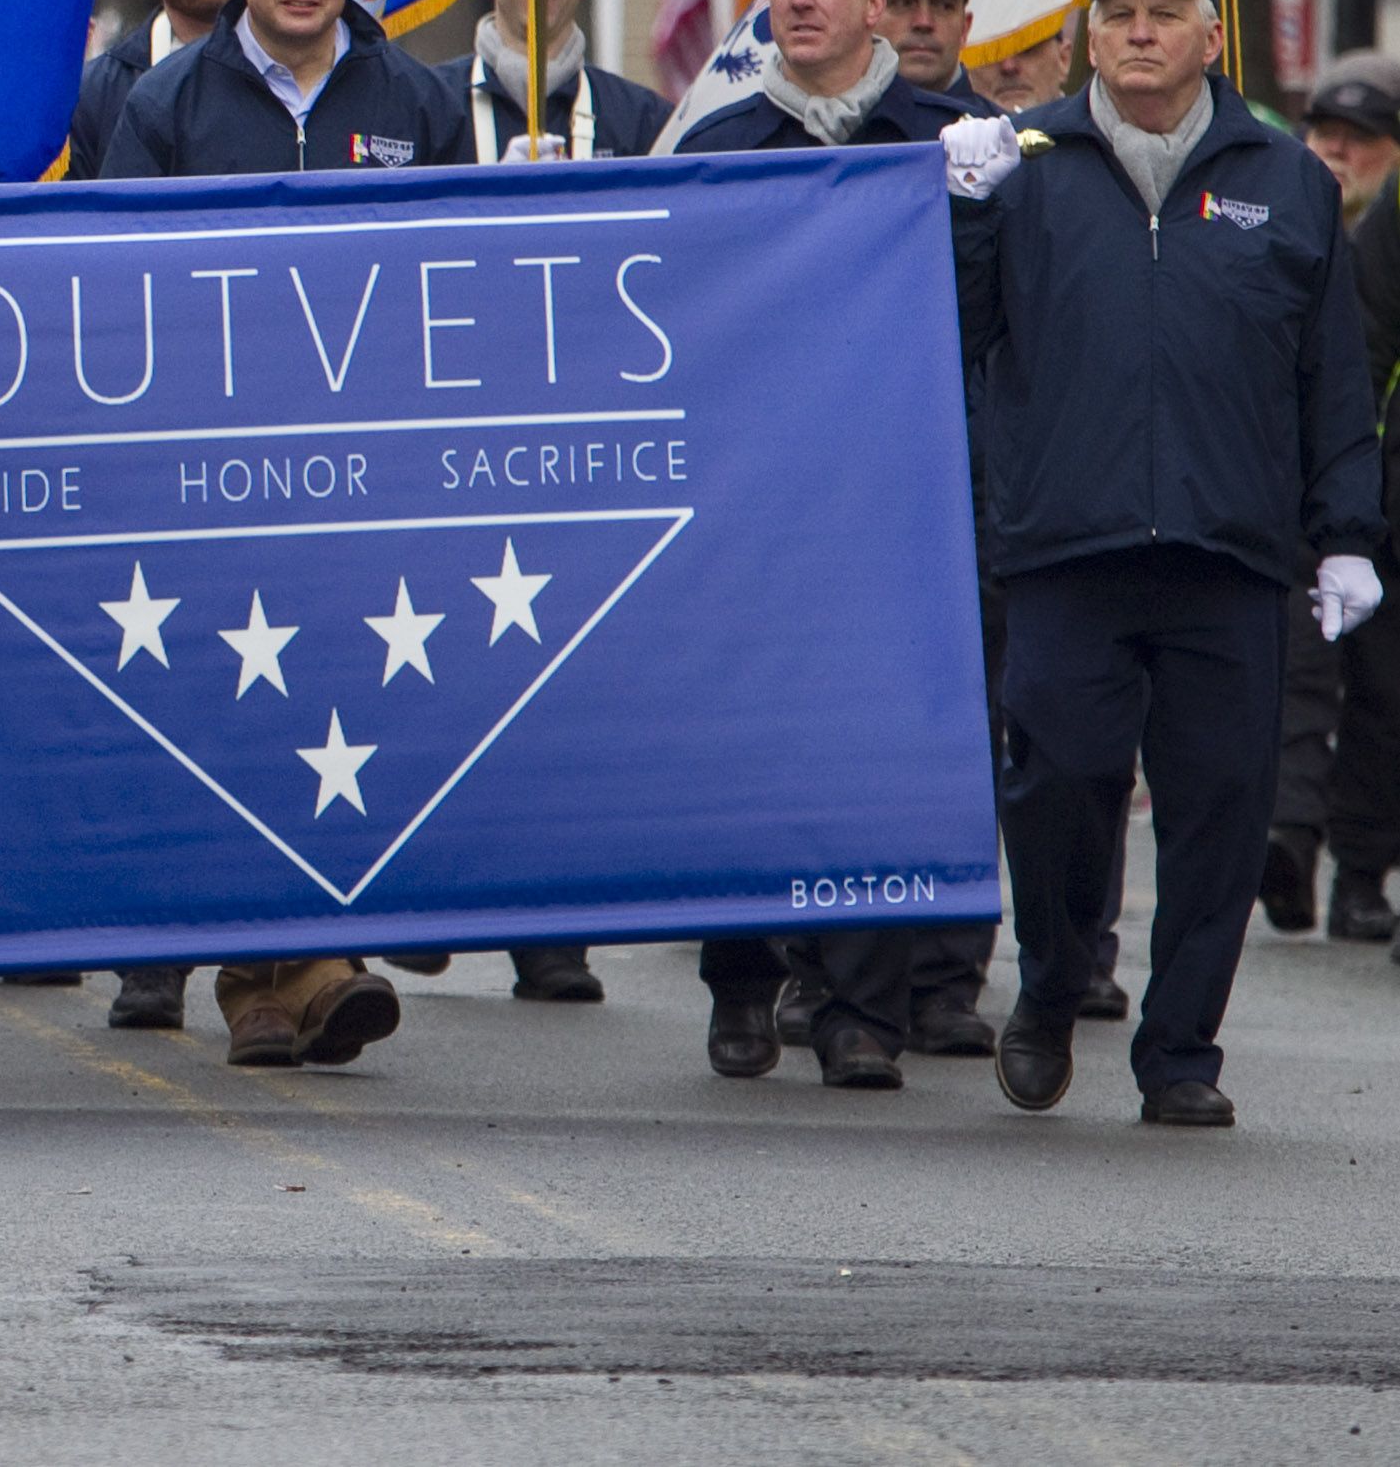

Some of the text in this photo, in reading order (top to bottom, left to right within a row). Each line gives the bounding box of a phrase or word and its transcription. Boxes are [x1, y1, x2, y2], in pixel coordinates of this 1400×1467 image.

[180, 452, 368, 504] HONOR
[441, 439, 688, 490] SACRIFICE
[791, 874, 935, 909] BOSTON
